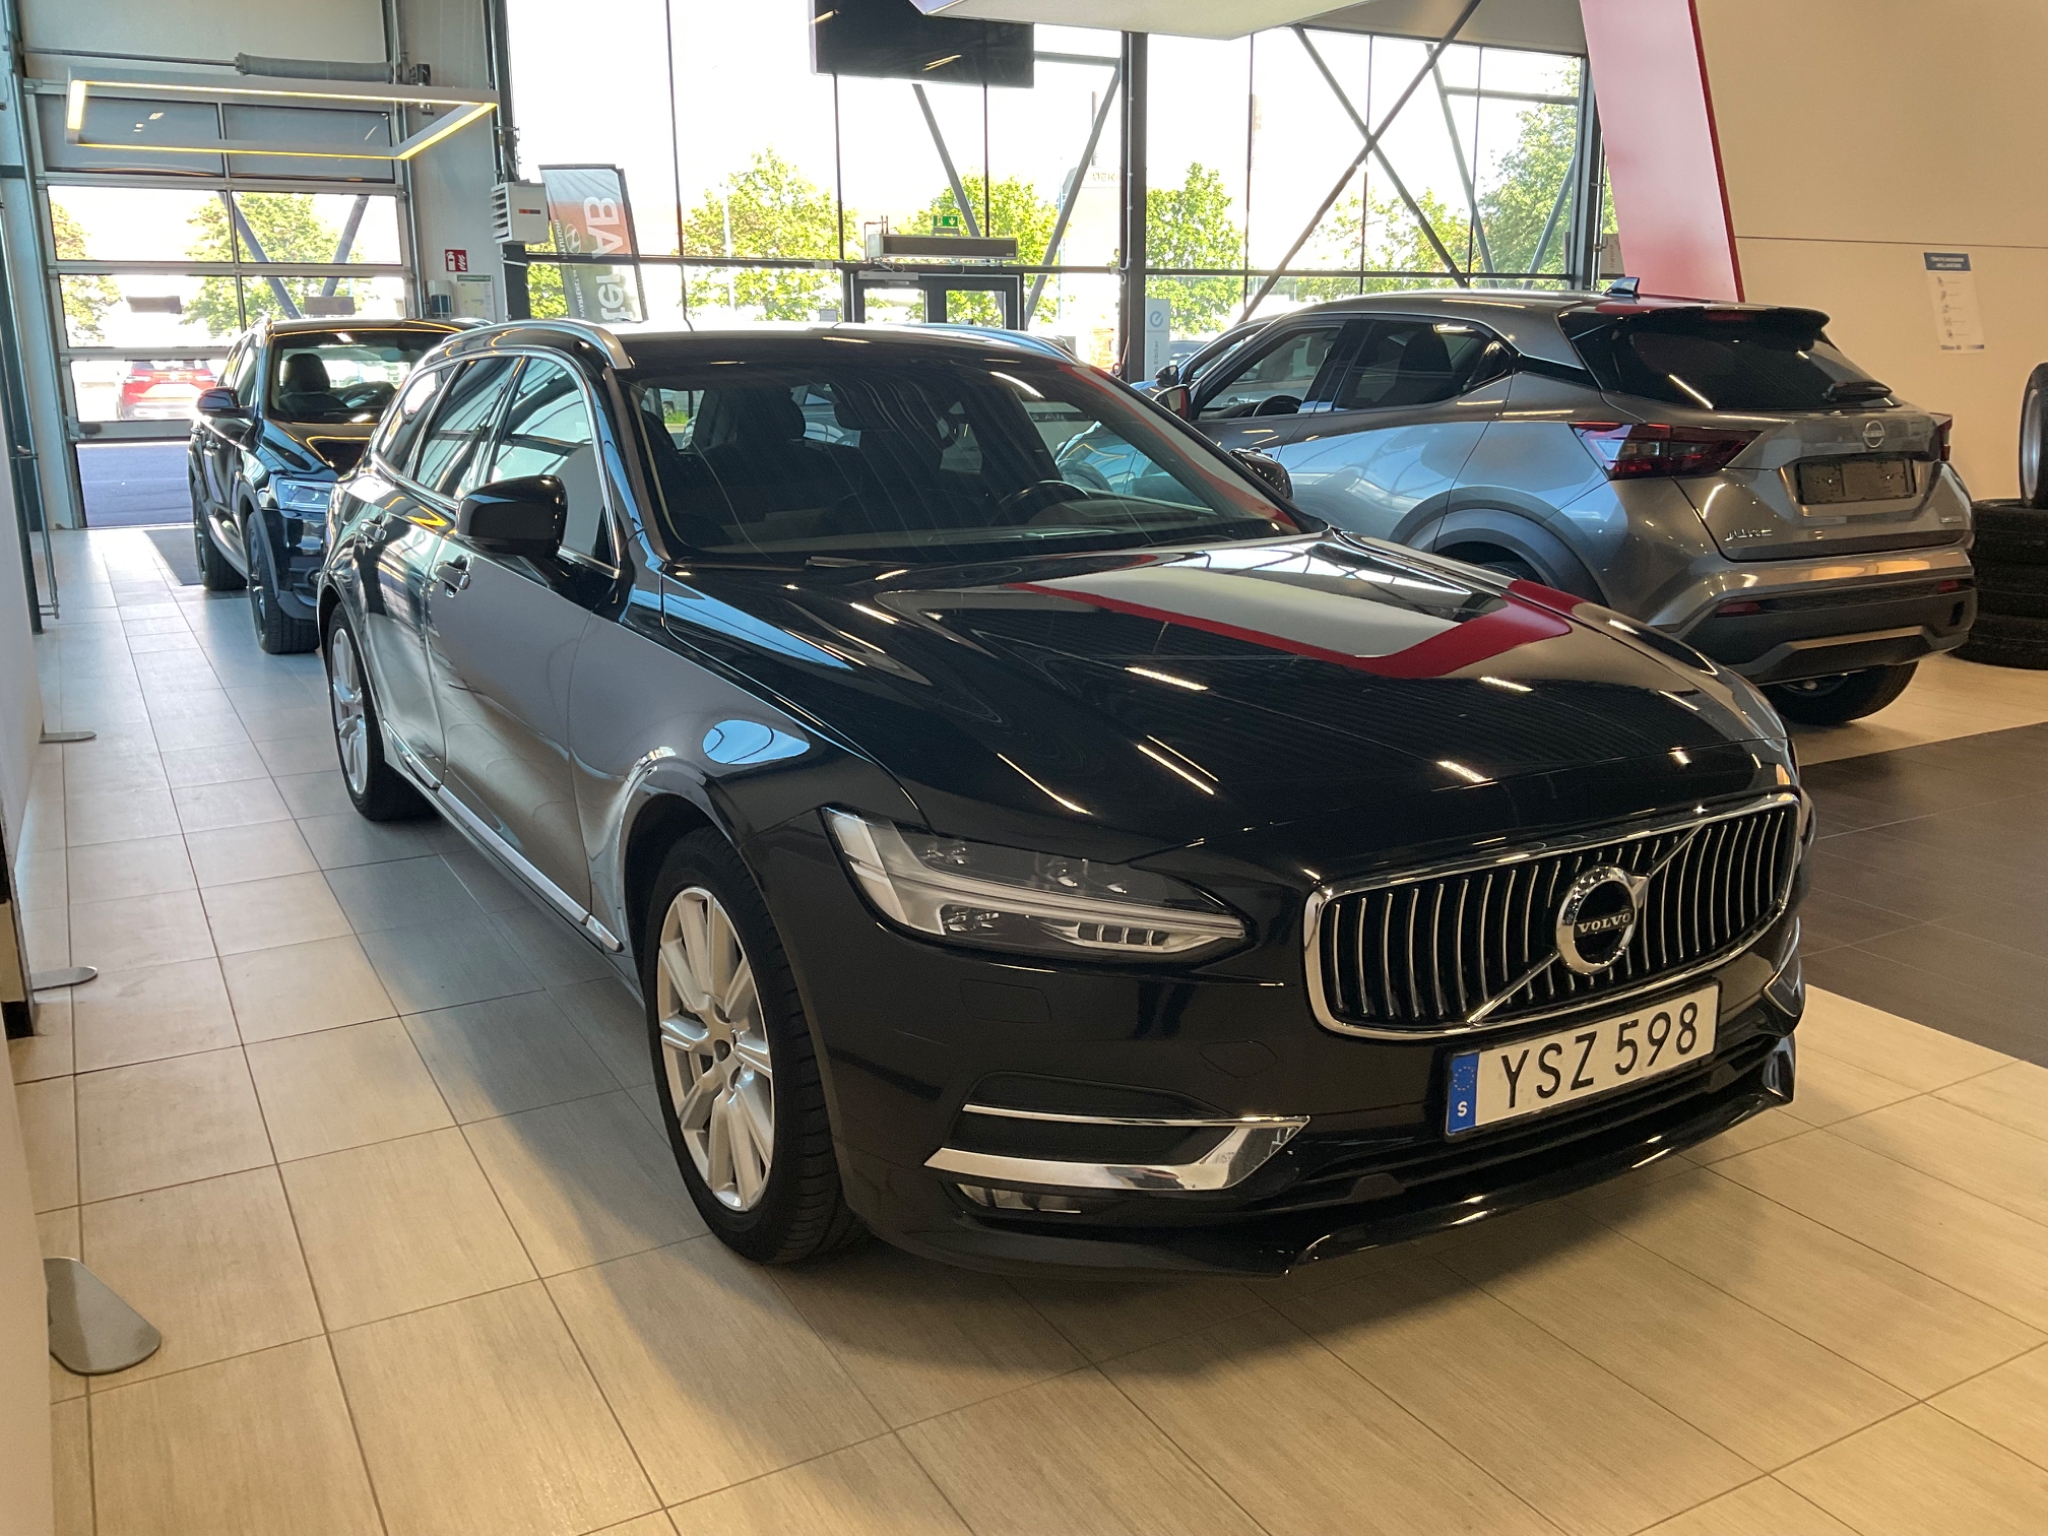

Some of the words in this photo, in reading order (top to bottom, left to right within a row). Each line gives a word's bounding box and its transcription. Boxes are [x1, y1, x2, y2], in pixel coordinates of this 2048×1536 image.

[1577, 912, 1632, 934] VOLVO
[1501, 1030, 1598, 1109] YSZ
[1614, 1001, 1699, 1076] 598
[1457, 1100, 1468, 1118] S
